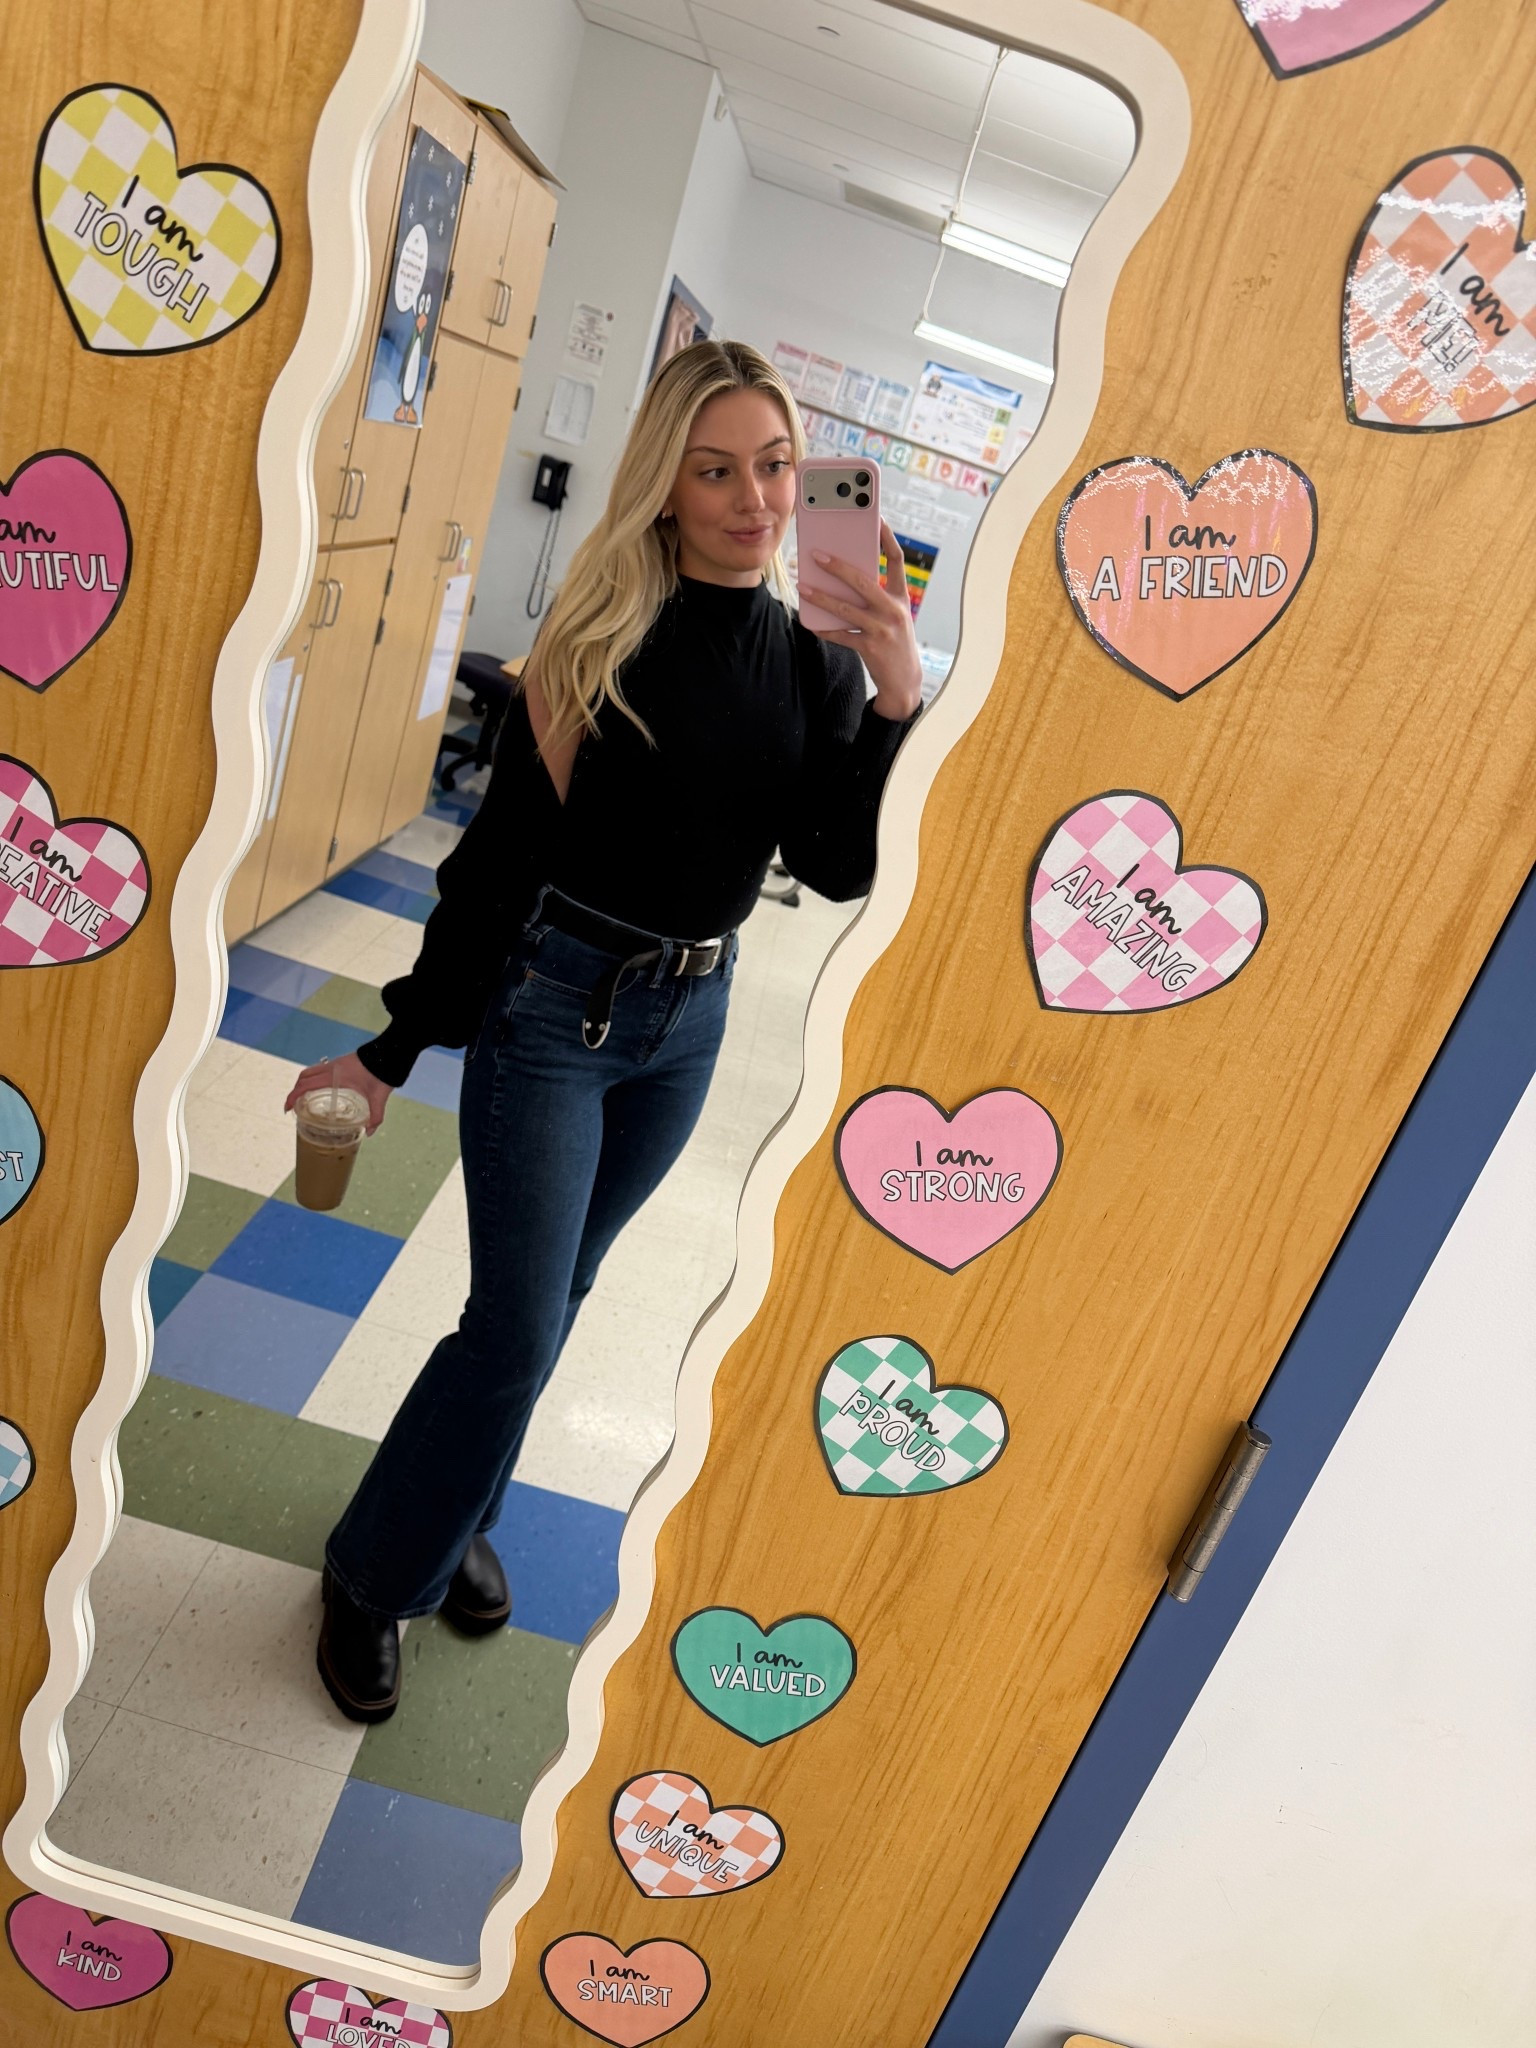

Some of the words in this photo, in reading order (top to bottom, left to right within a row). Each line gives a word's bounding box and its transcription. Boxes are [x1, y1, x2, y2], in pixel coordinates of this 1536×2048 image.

[121, 174, 140, 209] I
[144, 204, 204, 262] am
[74, 191, 210, 323] TOUGH
[1439, 242, 1470, 275] I
[1459, 275, 1511, 337] am
[1145, 515, 1152, 551] I
[1168, 524, 1237, 550] am
[0, 550, 119, 592] UTIFUL
[1089, 556, 1122, 601] A
[1139, 554, 1288, 600] FRIEND
[9, 815, 24, 842] I
[29, 839, 82, 882] am
[0, 843, 113, 942] EATIVE
[1116, 863, 1140, 889] I
[1134, 888, 1182, 935] am
[1050, 864, 1198, 992] AMAZING
[915, 1140, 922, 1167] I
[936, 1147, 994, 1168] am
[879, 1169, 1026, 1203] STRONG
[878, 1379, 896, 1400] I
[895, 1398, 940, 1435] am
[838, 1389, 946, 1472] PROUD
[736, 1642, 742, 1663] I
[753, 1650, 803, 1668] am
[709, 1664, 827, 1697] VALUED
[667, 1809, 680, 1827] I
[682, 1823, 725, 1850] am
[635, 1820, 740, 1884] UNIQUE
[56, 1947, 123, 1982] KIND
[66, 1930, 72, 1946] I
[81, 1940, 123, 1962] am
[589, 1959, 595, 1977] I
[605, 1966, 651, 1981] am
[576, 1978, 673, 2008] SMART
[344, 2007, 351, 2023] I
[360, 2016, 402, 2035] am
